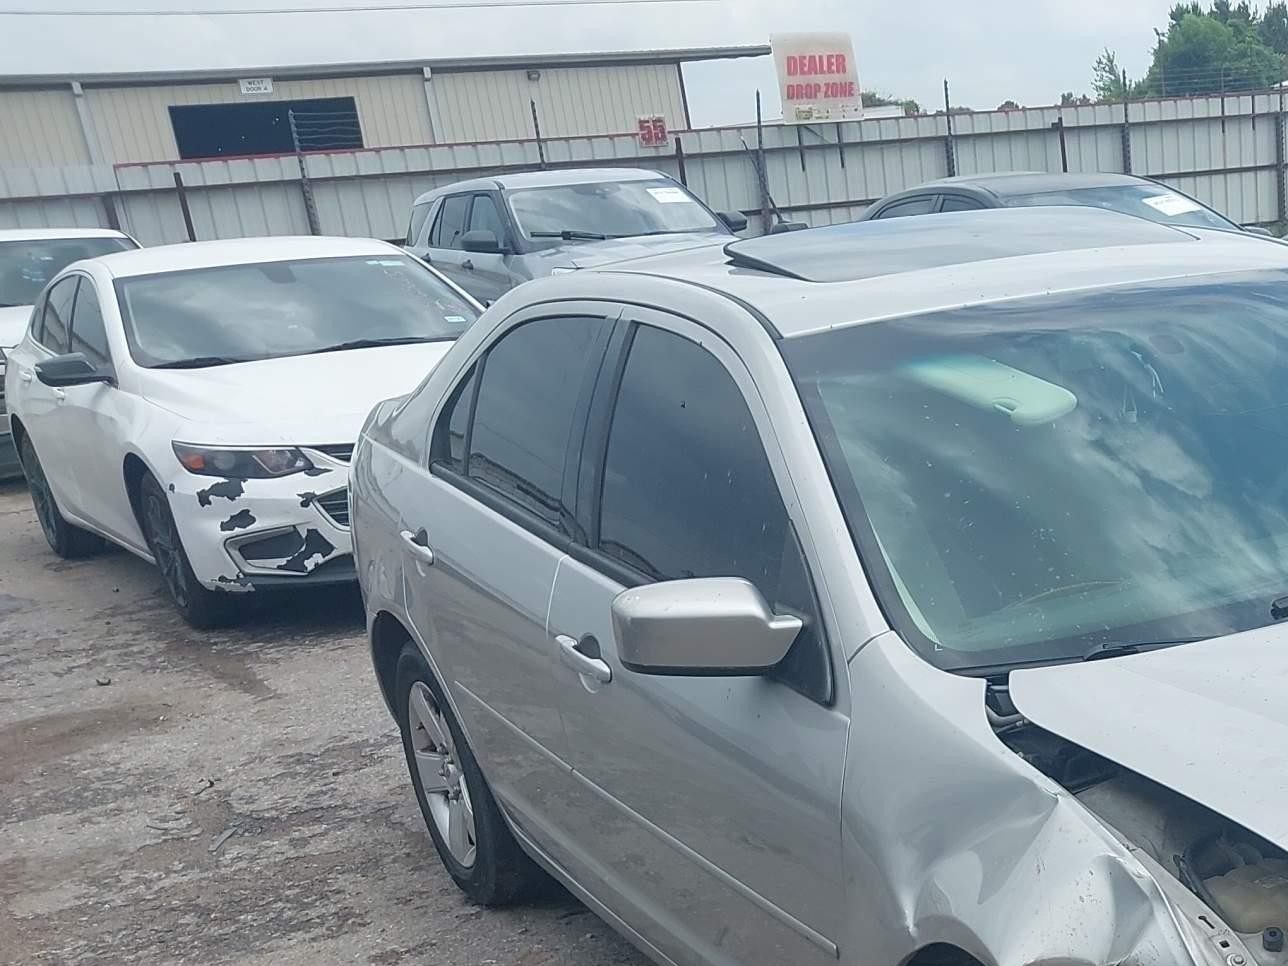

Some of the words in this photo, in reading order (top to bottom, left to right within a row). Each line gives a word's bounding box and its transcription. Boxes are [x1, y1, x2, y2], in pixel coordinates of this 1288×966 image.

[786, 54, 847, 76] DEALER
[786, 83, 821, 100] DROP
[823, 81, 855, 98] ZONE
